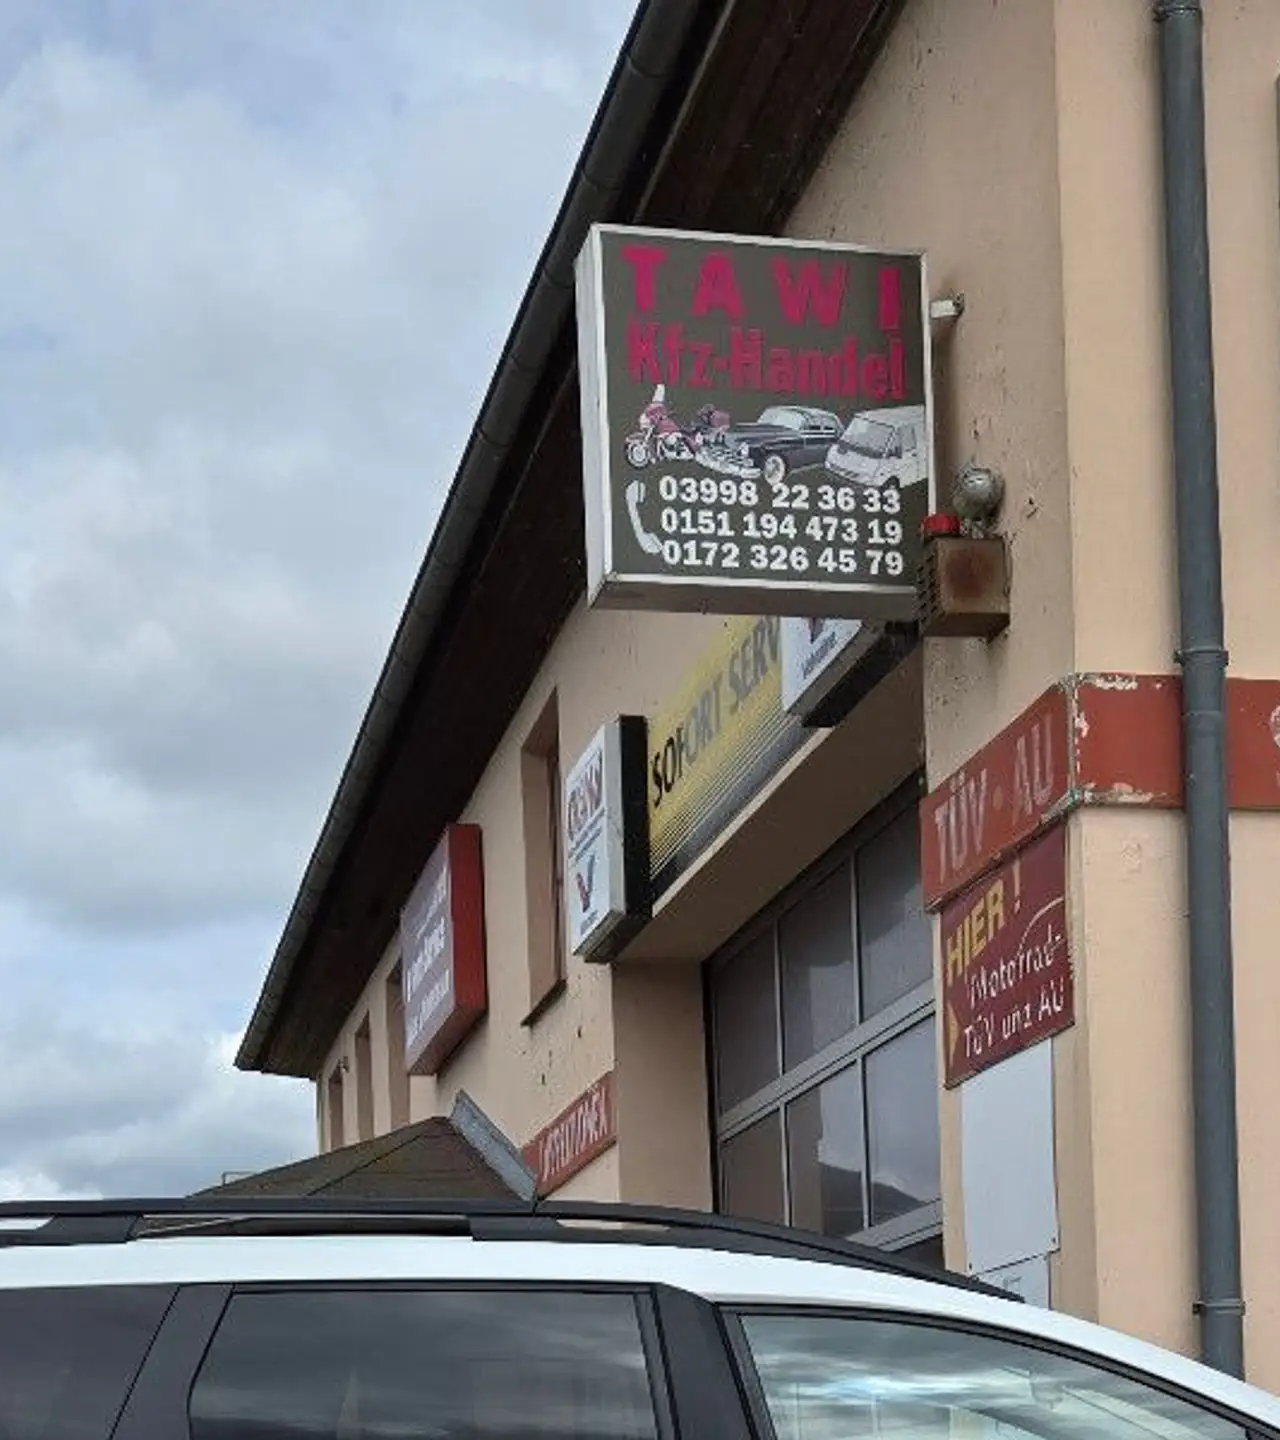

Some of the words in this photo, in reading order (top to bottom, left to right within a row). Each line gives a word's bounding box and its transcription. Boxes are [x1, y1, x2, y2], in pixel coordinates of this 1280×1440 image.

[626, 316, 906, 400] Kfz-Handel
[659, 476, 759, 506] 03998
[772, 483, 809, 509] 22
[817, 485, 856, 511] 36
[862, 487, 901, 514] 33
[661, 508, 735, 536] 0151
[743, 511, 797, 539] 194
[806, 516, 858, 542] 473
[867, 519, 903, 544] 19
[662, 540, 740, 568] 0172
[750, 545, 810, 571] 326
[817, 548, 857, 573] 45
[866, 550, 904, 575] 79
[934, 768, 988, 884] TÜV
[1013, 712, 1055, 827] AU
